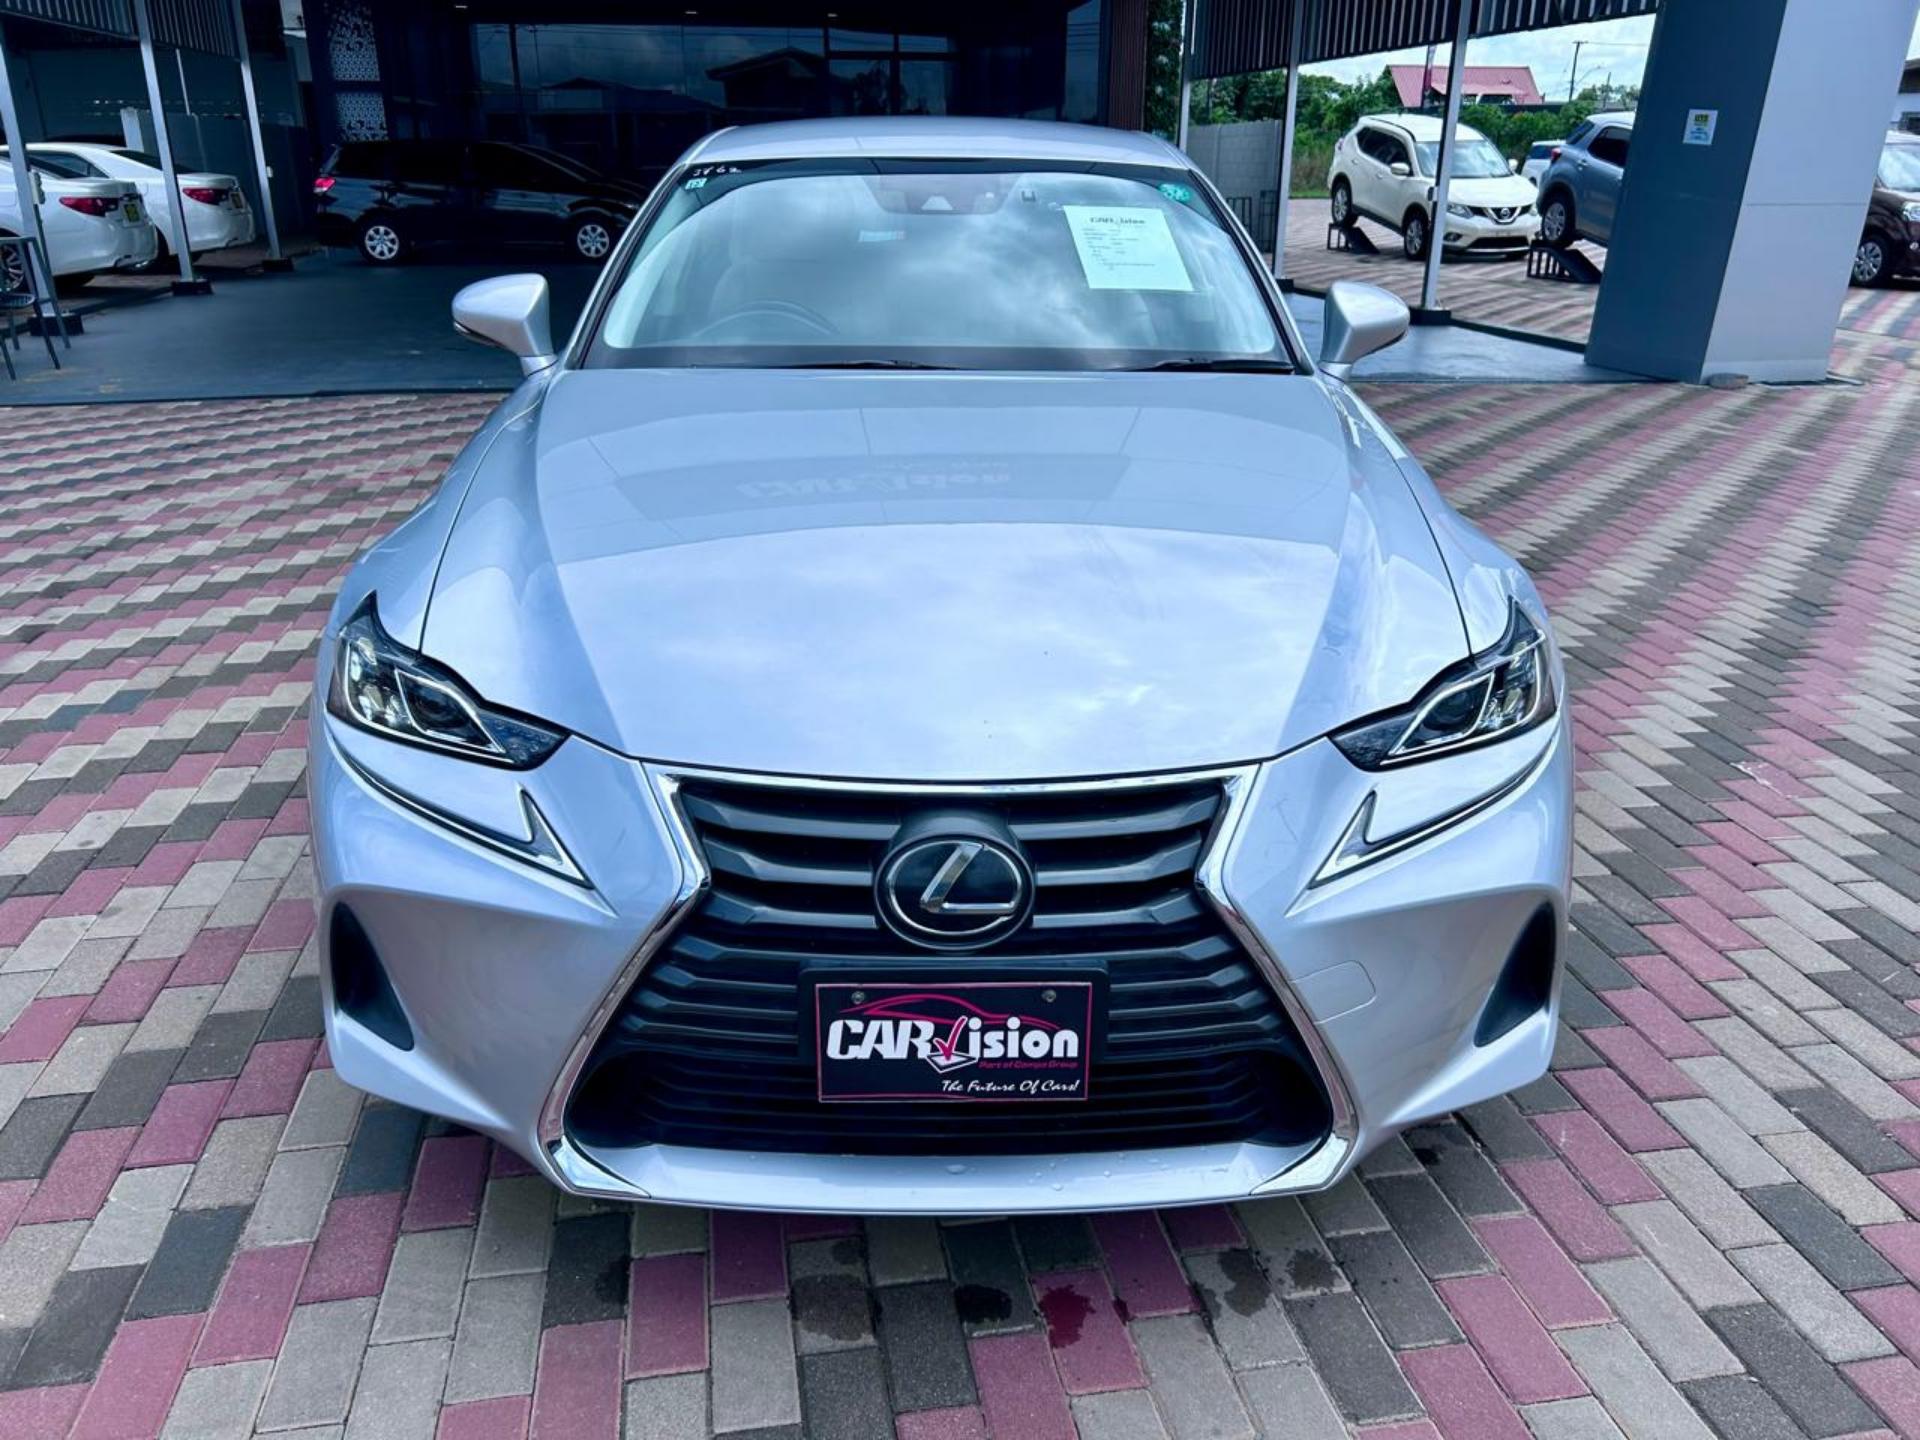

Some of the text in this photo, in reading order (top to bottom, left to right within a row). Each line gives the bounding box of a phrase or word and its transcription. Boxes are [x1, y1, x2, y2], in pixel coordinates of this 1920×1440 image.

[942, 1080, 964, 1092] The
[967, 1080, 1016, 1092] Future
[1020, 1080, 1040, 1095] Of
